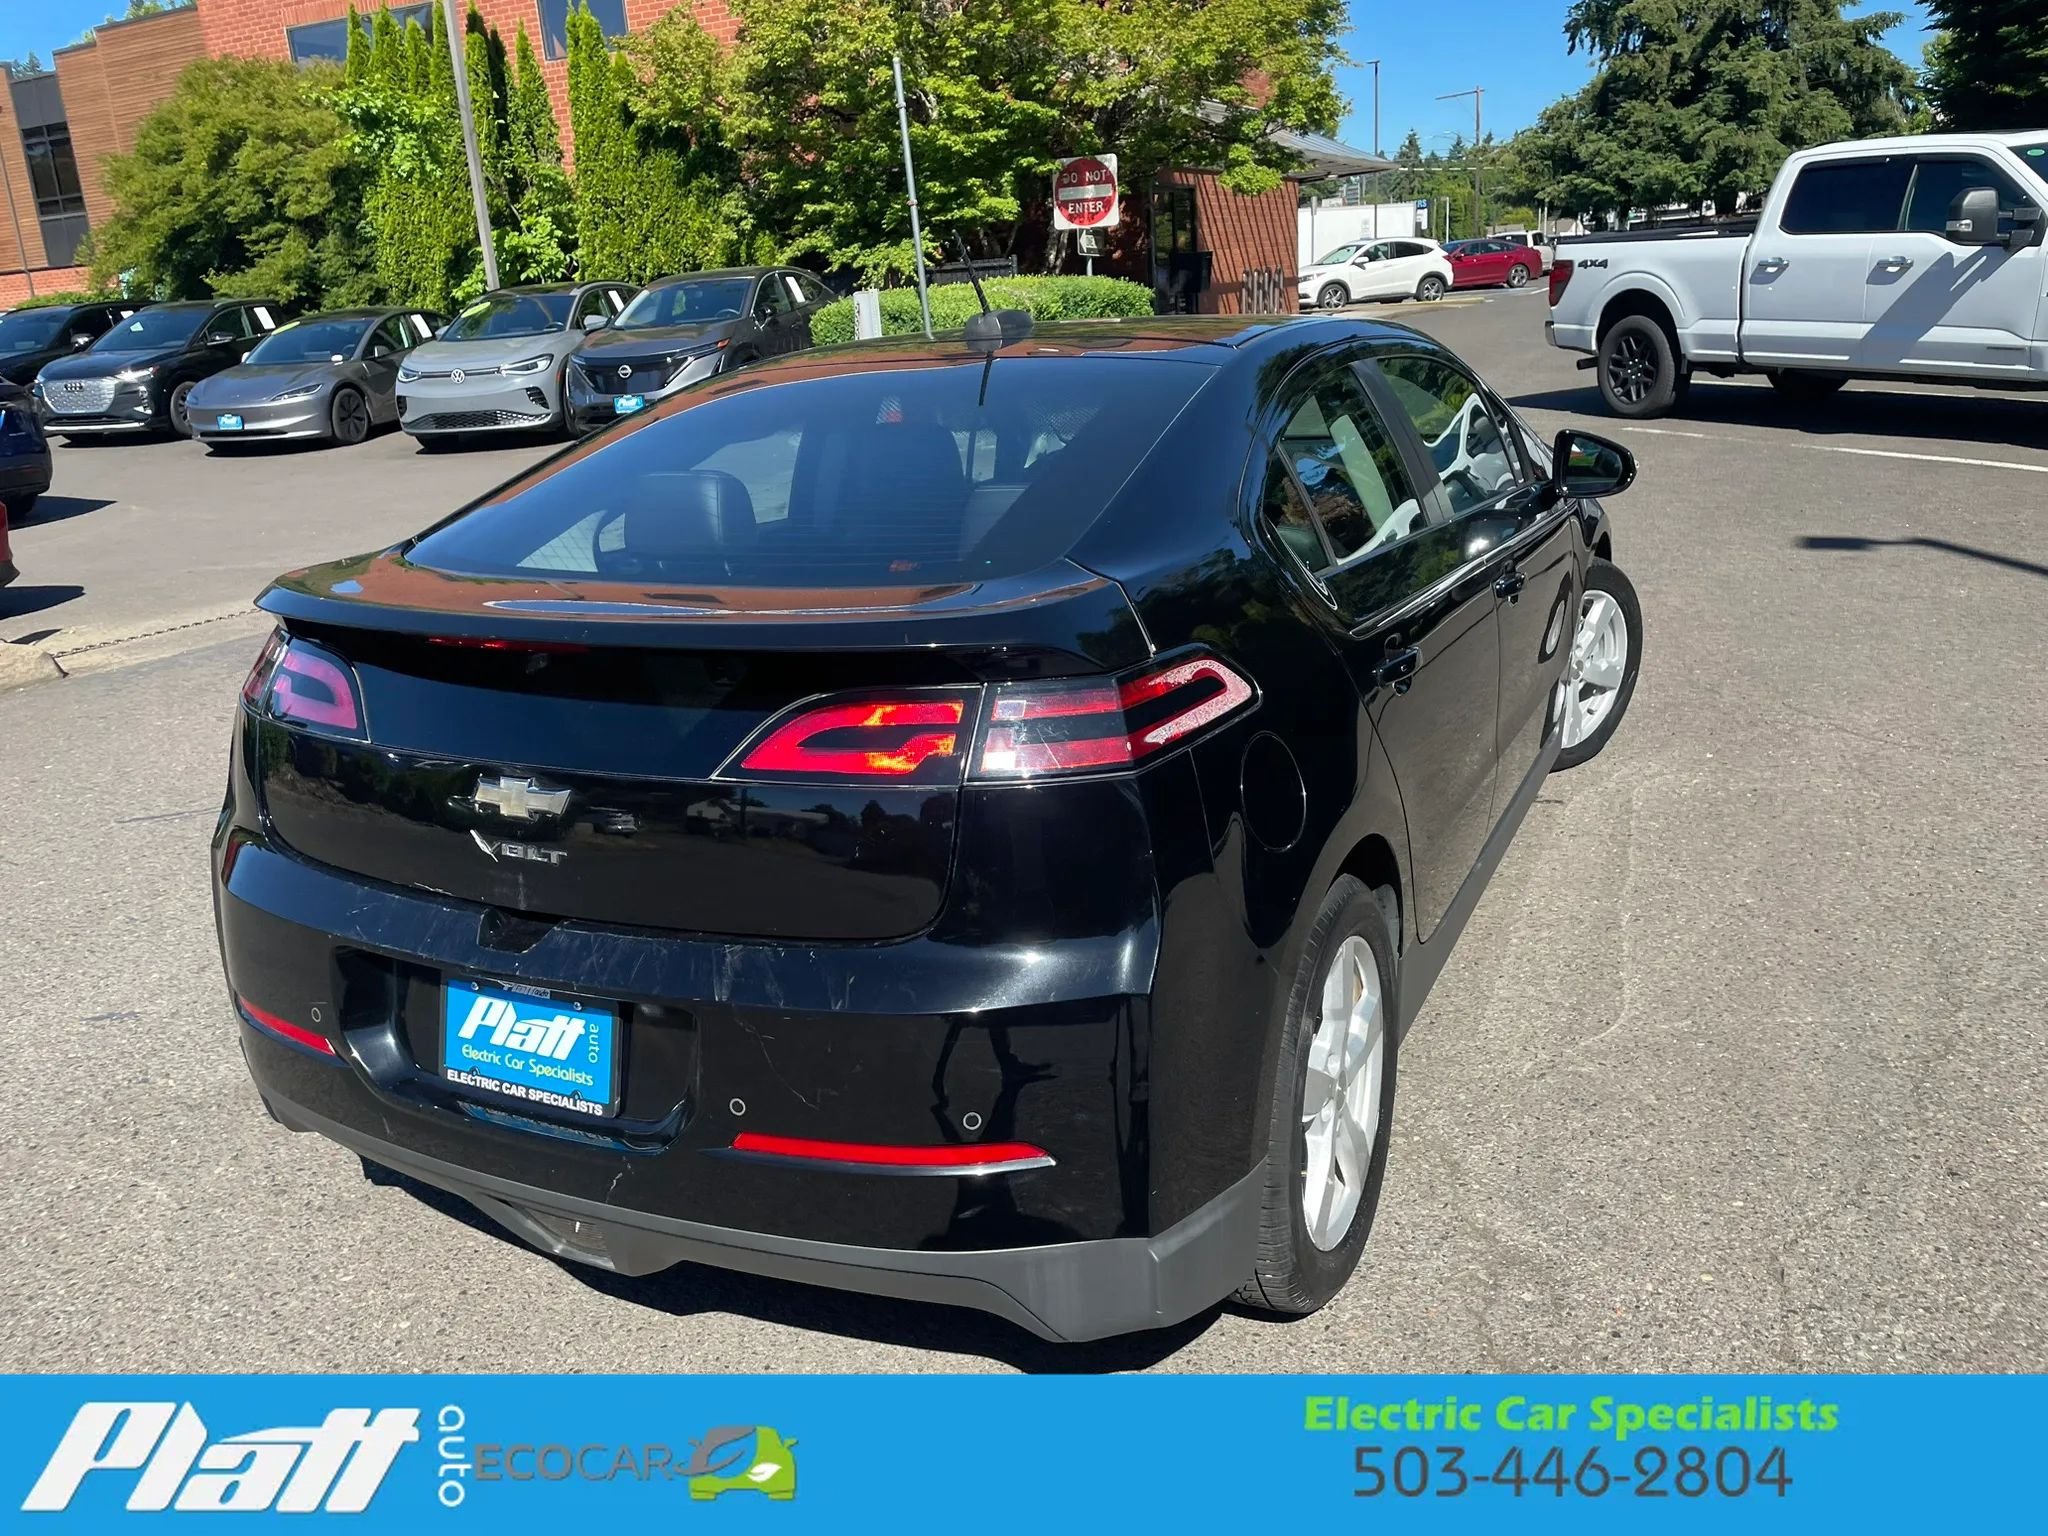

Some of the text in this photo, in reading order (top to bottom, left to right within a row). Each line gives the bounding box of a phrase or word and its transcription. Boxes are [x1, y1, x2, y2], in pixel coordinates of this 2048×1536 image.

[1062, 169, 1107, 184] DO NOT
[1068, 201, 1103, 214] ENTER
[469, 829, 568, 867] VOLT
[588, 1023, 601, 1064] auto
[461, 1043, 594, 1087] Electric Car Specialists
[446, 1069, 604, 1116] ELECTRIC CAR SPECIALISTS
